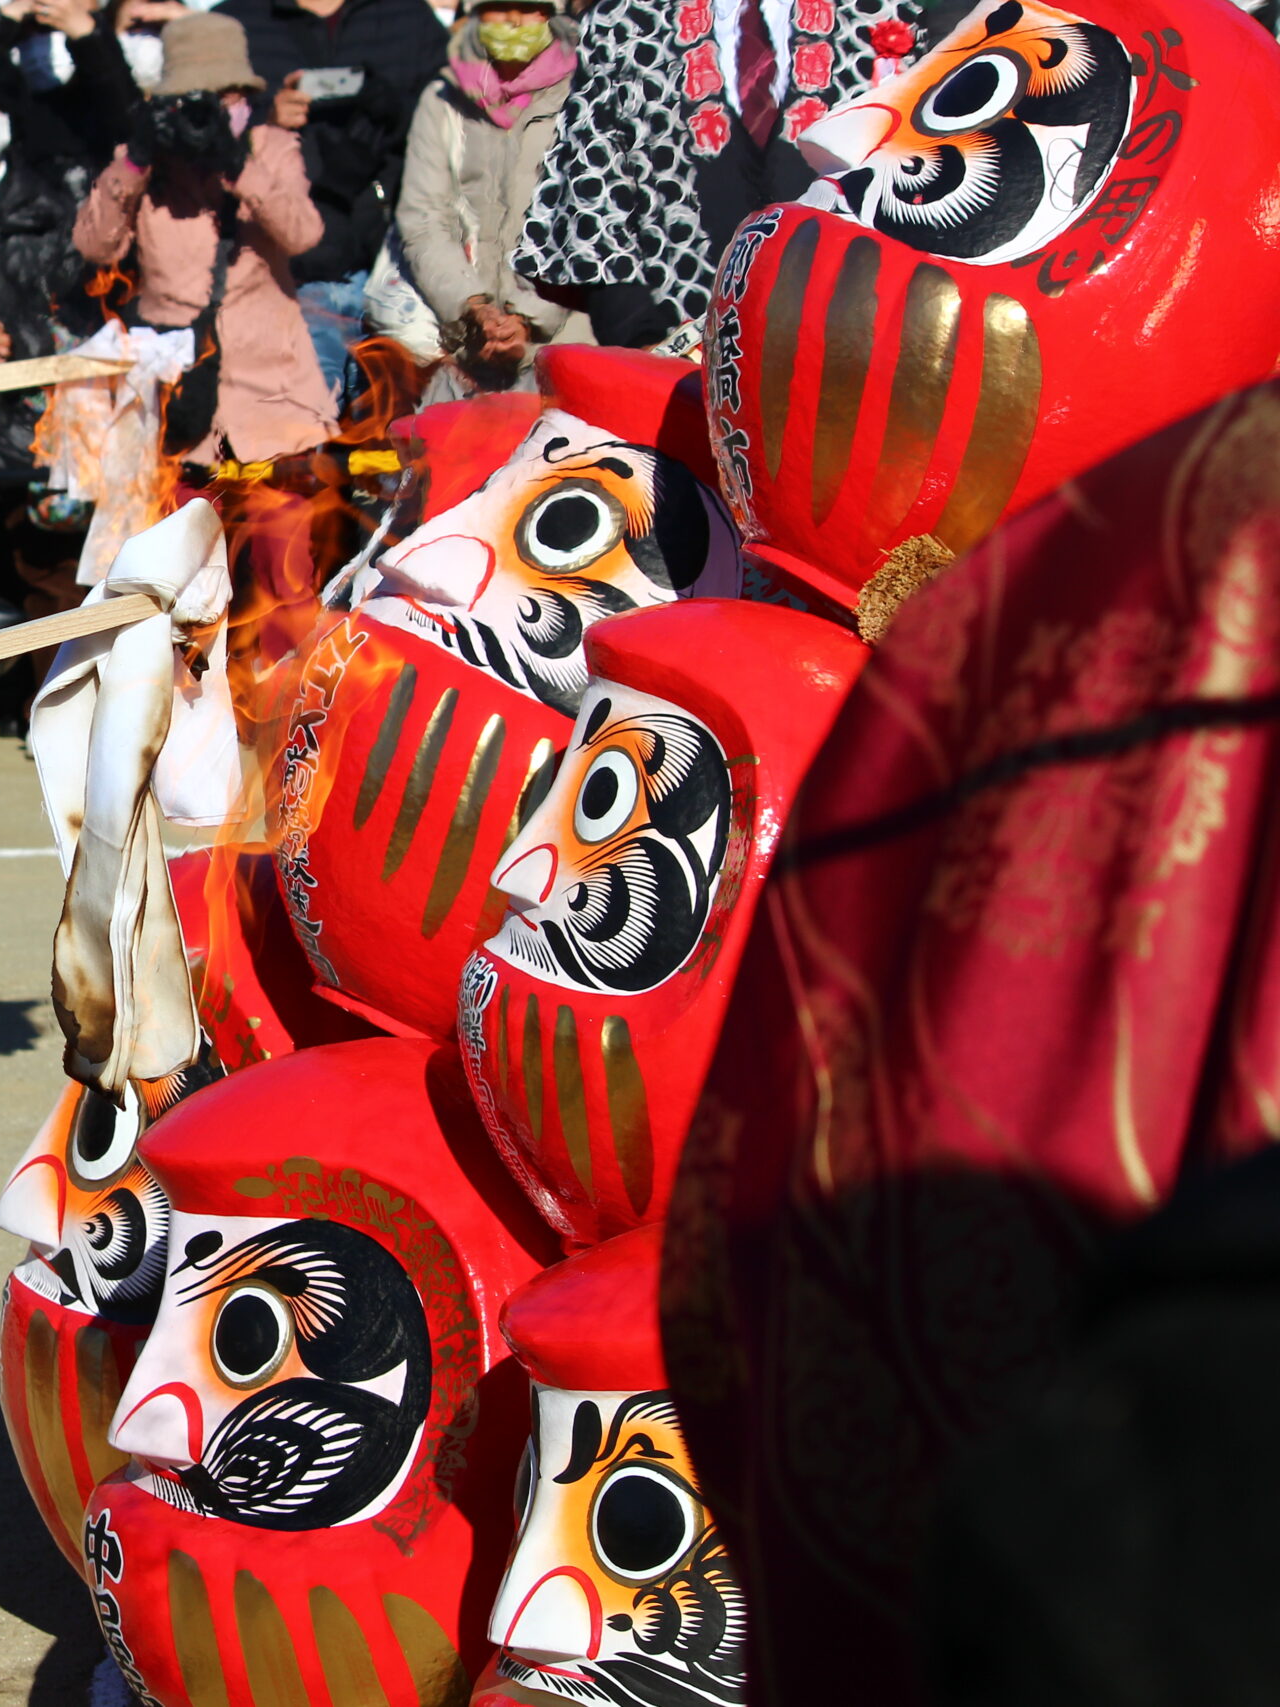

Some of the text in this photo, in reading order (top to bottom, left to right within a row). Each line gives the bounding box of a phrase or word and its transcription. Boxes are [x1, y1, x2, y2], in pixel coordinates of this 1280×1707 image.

[1010, 28, 1200, 298] 火の用心
[704, 206, 785, 524] 前橋市
